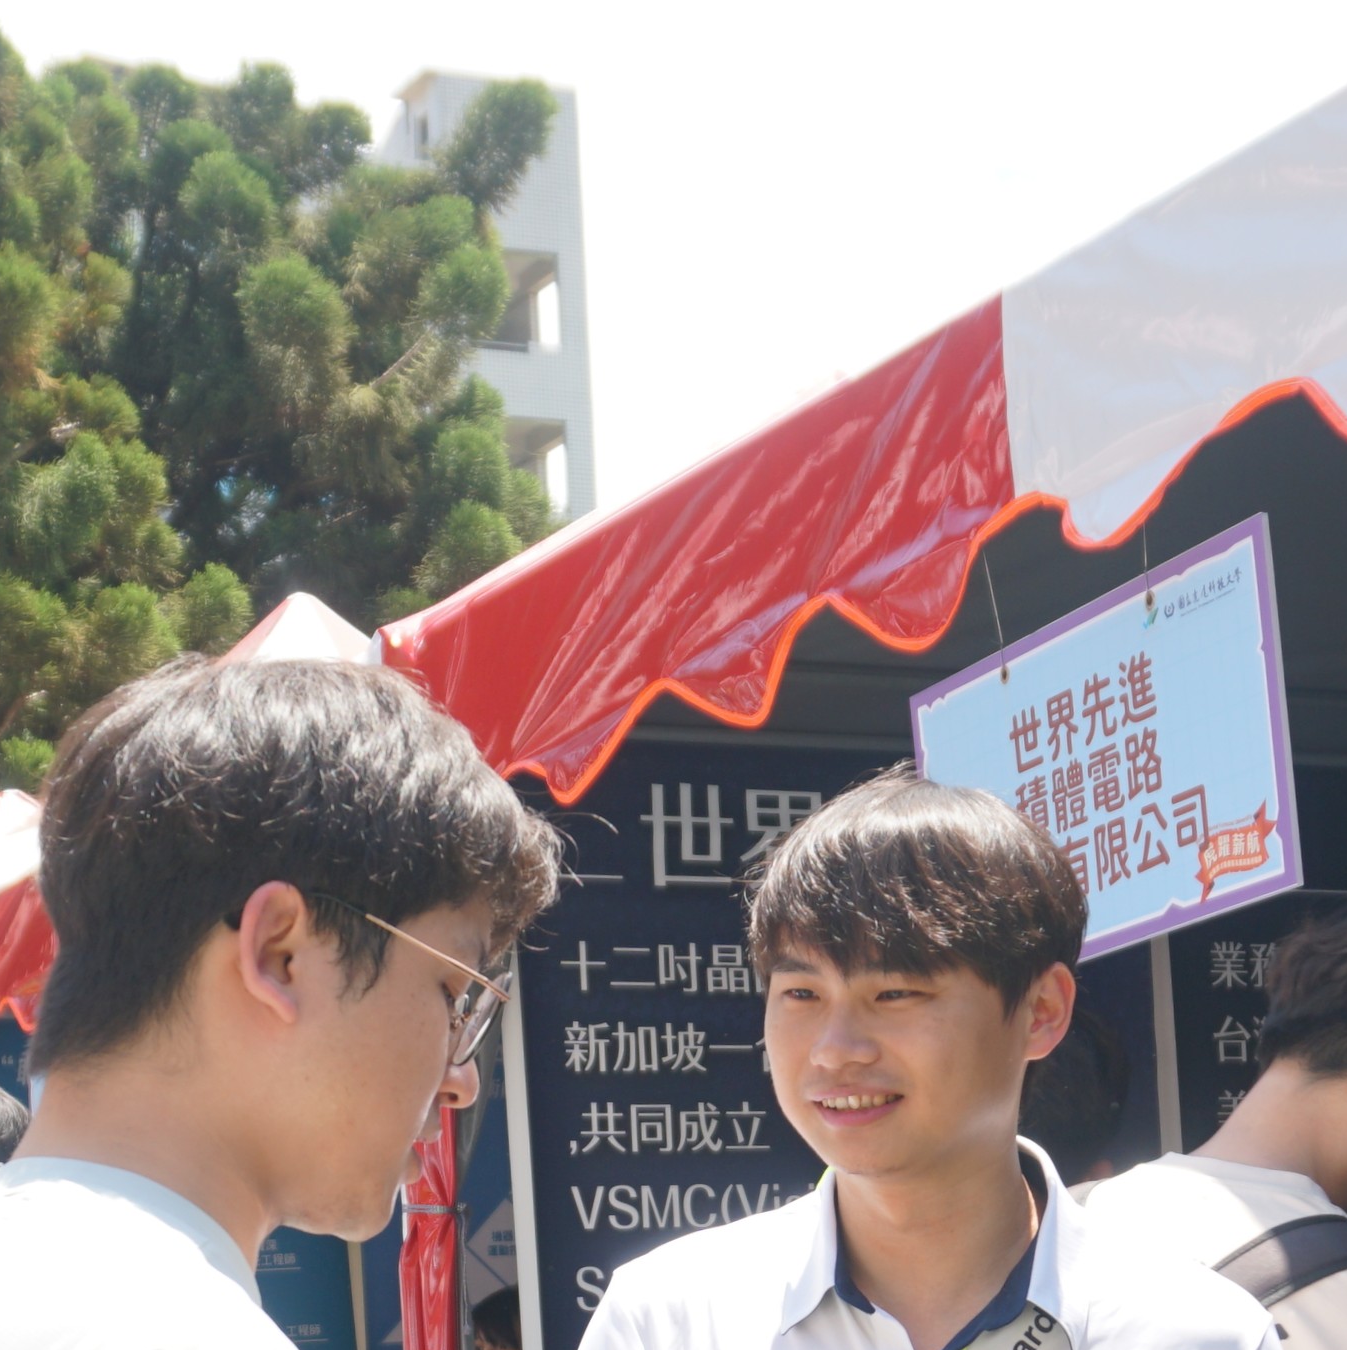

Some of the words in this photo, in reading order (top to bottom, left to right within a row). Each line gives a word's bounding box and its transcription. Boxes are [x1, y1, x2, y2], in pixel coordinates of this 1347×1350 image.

[1009, 651, 1157, 774] 世界先進
[1015, 727, 1163, 835] 積體電路
[560, 940, 763, 993] 十二吋晶
[564, 1021, 773, 1072] 新加坡一
